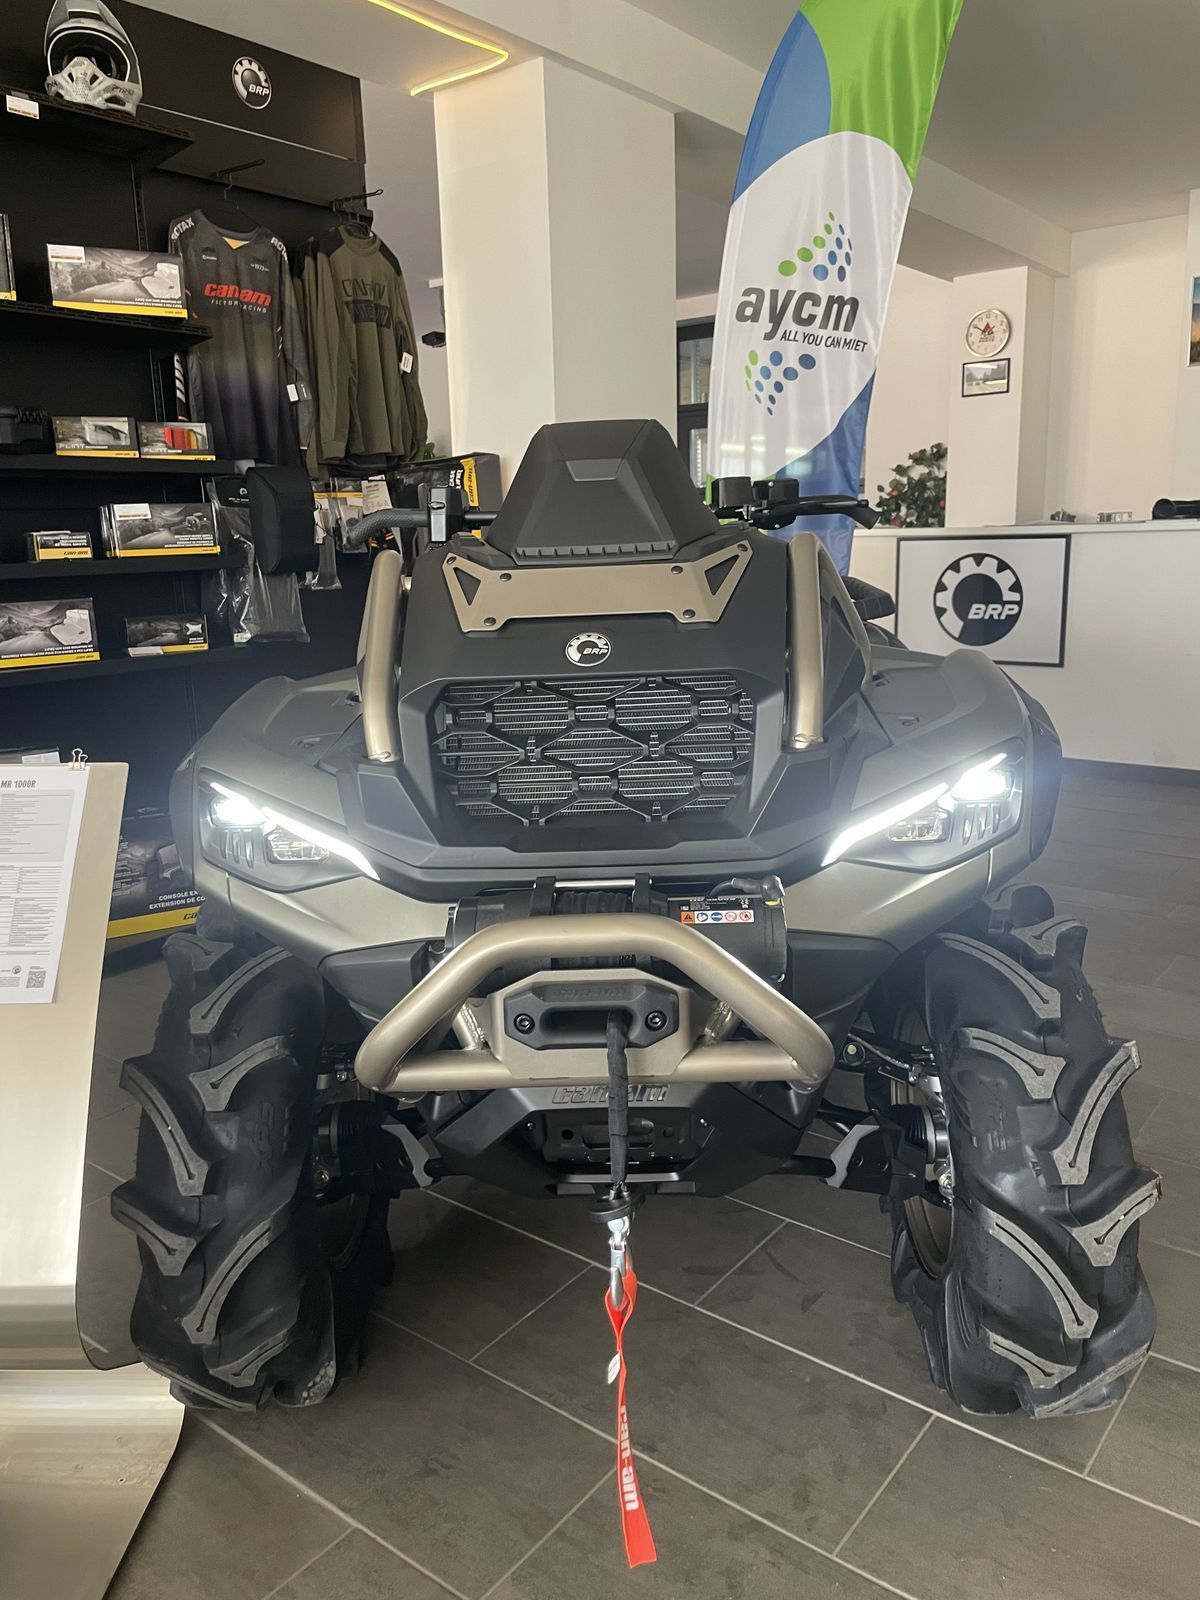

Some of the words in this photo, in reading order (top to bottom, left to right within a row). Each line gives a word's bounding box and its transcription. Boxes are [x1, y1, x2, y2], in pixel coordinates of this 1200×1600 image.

[249, 84, 269, 96] BRP
[735, 287, 859, 341] aycm
[780, 329, 799, 342] ALL
[802, 332, 823, 346] YOU
[824, 336, 842, 349] CAN
[842, 337, 868, 352] MIET
[967, 604, 1020, 621] BRP
[14, 779, 37, 788] 1000R
[159, 891, 188, 901] CONSOLE
[149, 898, 186, 910] EXTENSION
